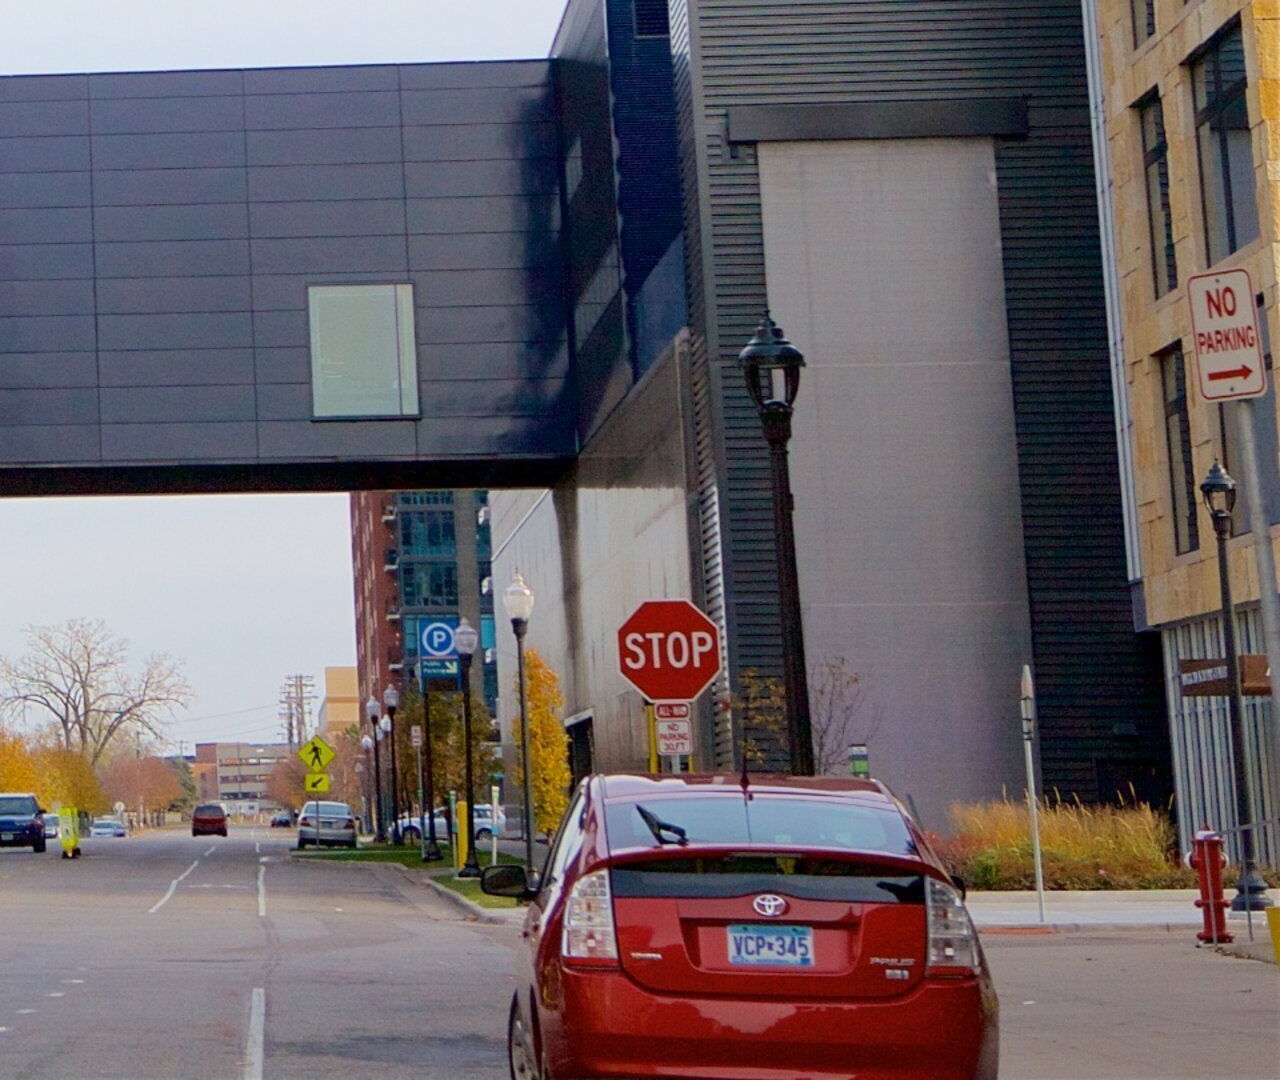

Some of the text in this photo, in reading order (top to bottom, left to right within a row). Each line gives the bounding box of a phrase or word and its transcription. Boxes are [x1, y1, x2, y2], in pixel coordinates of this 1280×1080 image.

[1205, 286, 1236, 319] NO
[1198, 325, 1255, 354] PARKING
[624, 631, 713, 670] STOP
[659, 733, 689, 741] PARKING
[667, 723, 679, 731] NO
